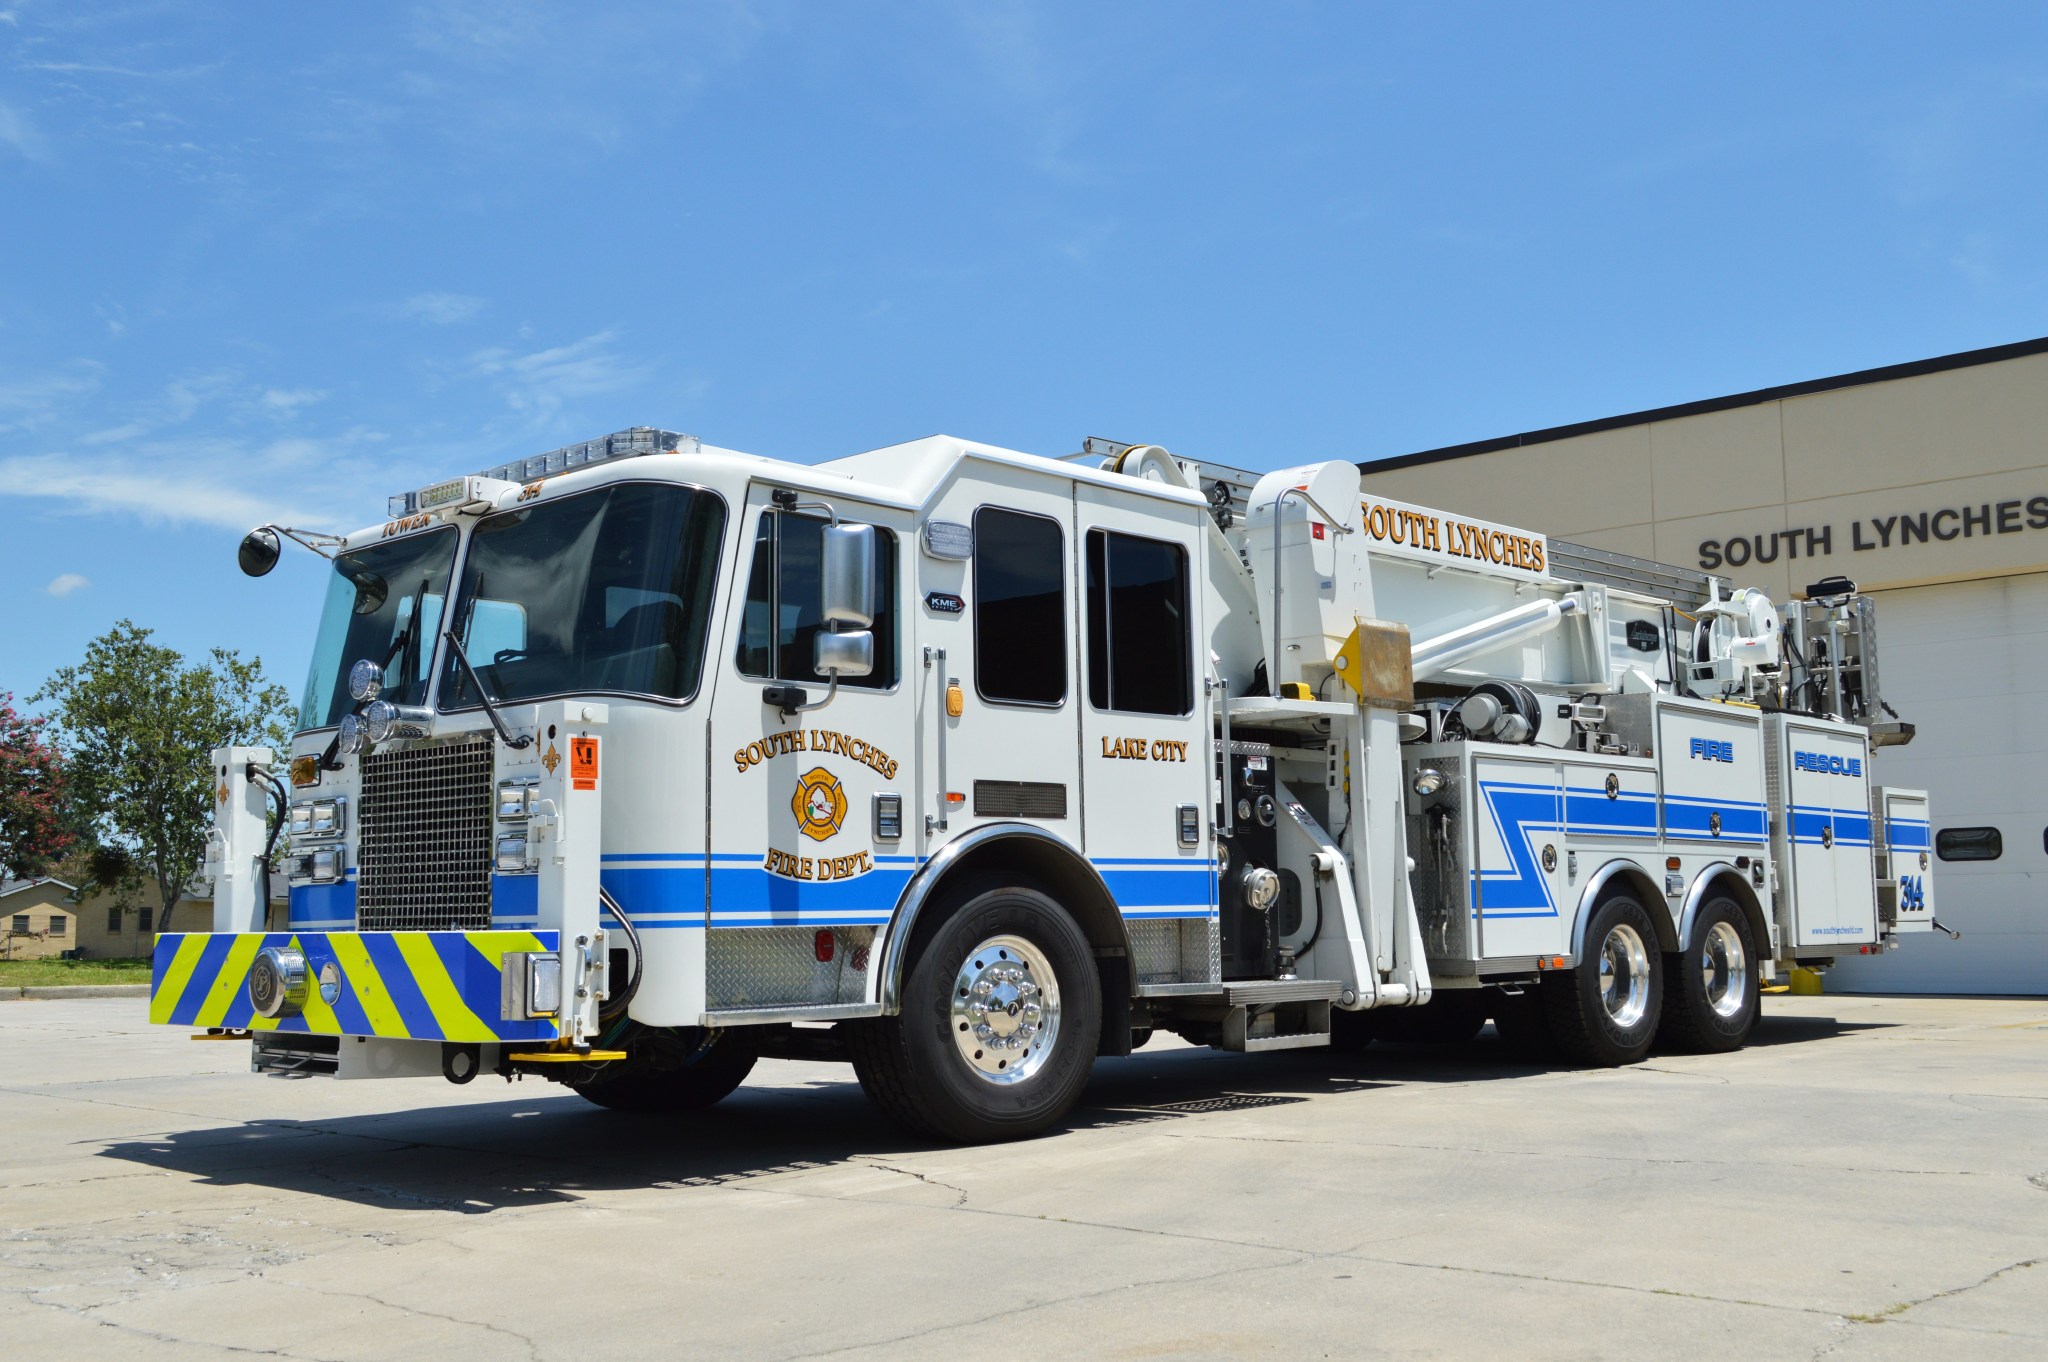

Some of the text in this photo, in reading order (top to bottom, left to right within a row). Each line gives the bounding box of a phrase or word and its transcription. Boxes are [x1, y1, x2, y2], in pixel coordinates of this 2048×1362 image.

[382, 512, 431, 538] TOWER
[1360, 501, 1545, 573] SOUTH LYNCHES
[1698, 496, 2048, 570] SOUTH LYNCHES
[931, 597, 957, 607] KME
[734, 729, 899, 780] SOUTH LYNCHES
[1102, 736, 1188, 762] LAKE CITY
[1689, 736, 1861, 777] FIRE RESCUE
[764, 847, 873, 880] FIRE DEPT.
[1900, 875, 1925, 912] 314
